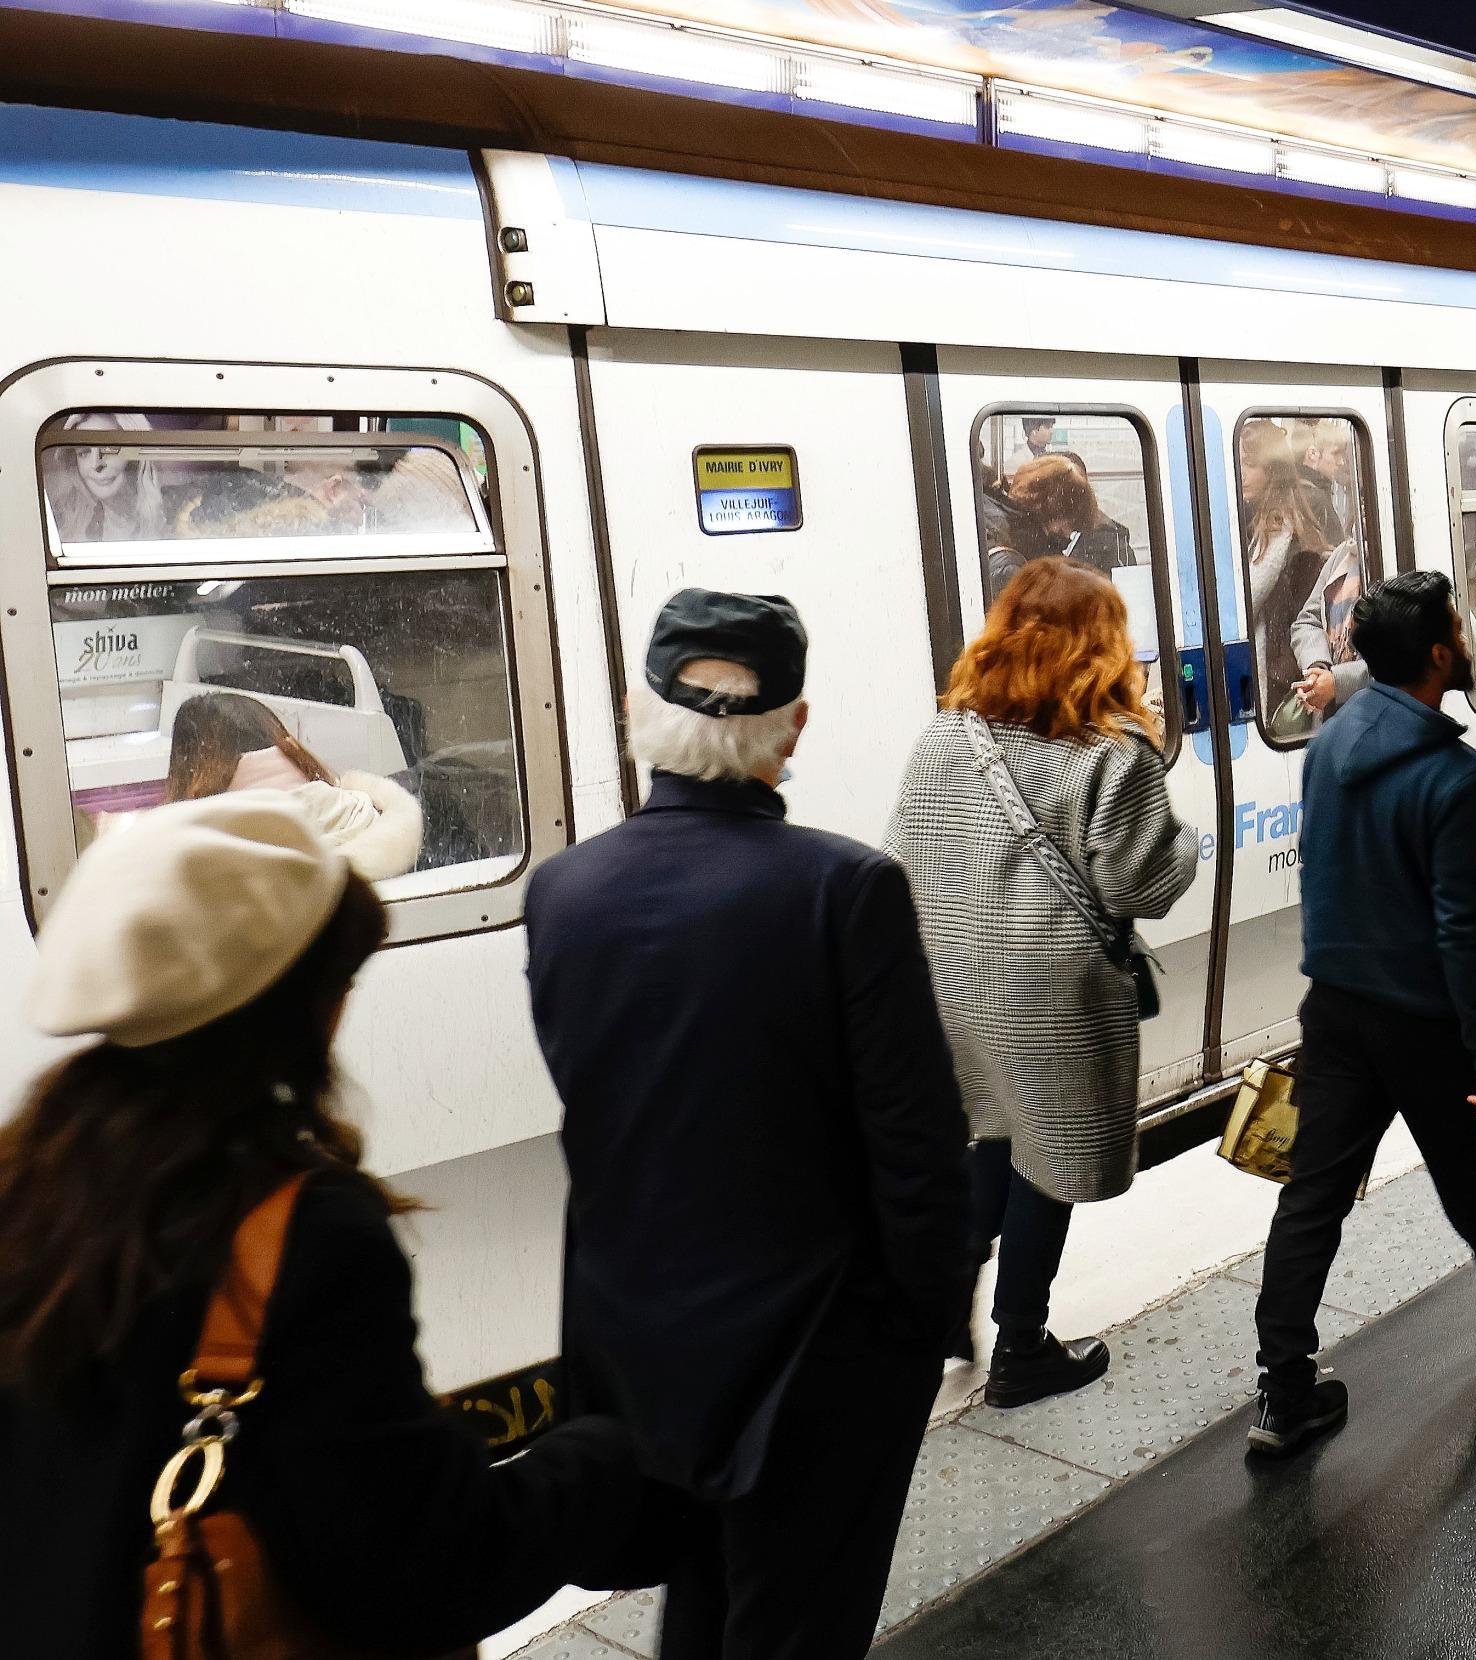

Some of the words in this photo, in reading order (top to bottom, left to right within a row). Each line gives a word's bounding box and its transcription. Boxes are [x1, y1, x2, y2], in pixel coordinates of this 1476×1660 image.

[705, 461, 744, 473] MAIRIE
[748, 459, 784, 473] D'IVRY
[64, 588, 107, 603] mon
[83, 624, 139, 654] shiva
[1235, 800, 1304, 849] Fran
